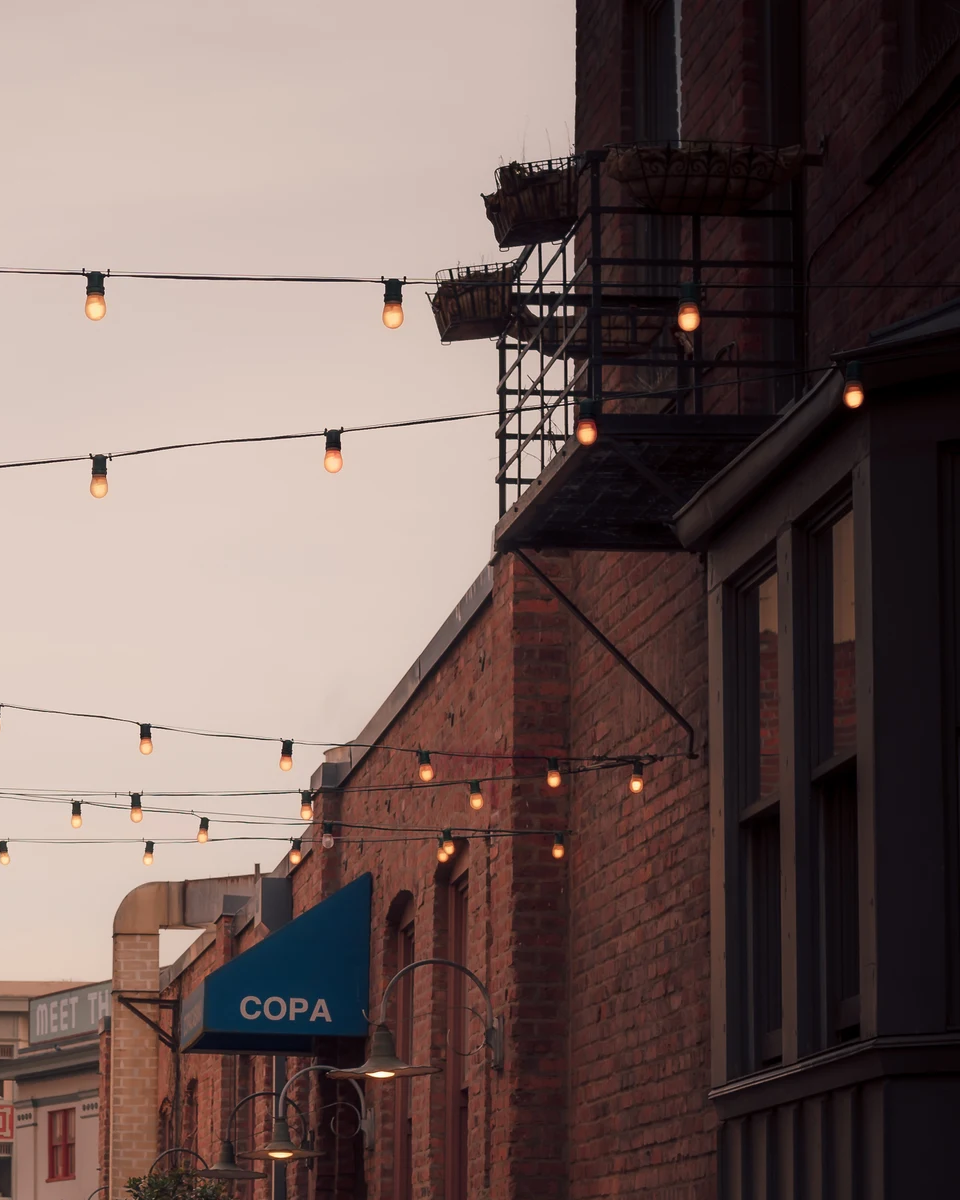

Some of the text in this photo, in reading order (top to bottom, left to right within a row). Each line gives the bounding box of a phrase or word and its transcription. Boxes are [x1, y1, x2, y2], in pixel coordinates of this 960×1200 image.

[36, 989, 109, 1036] MEET TH
[239, 995, 333, 1023] COPA
